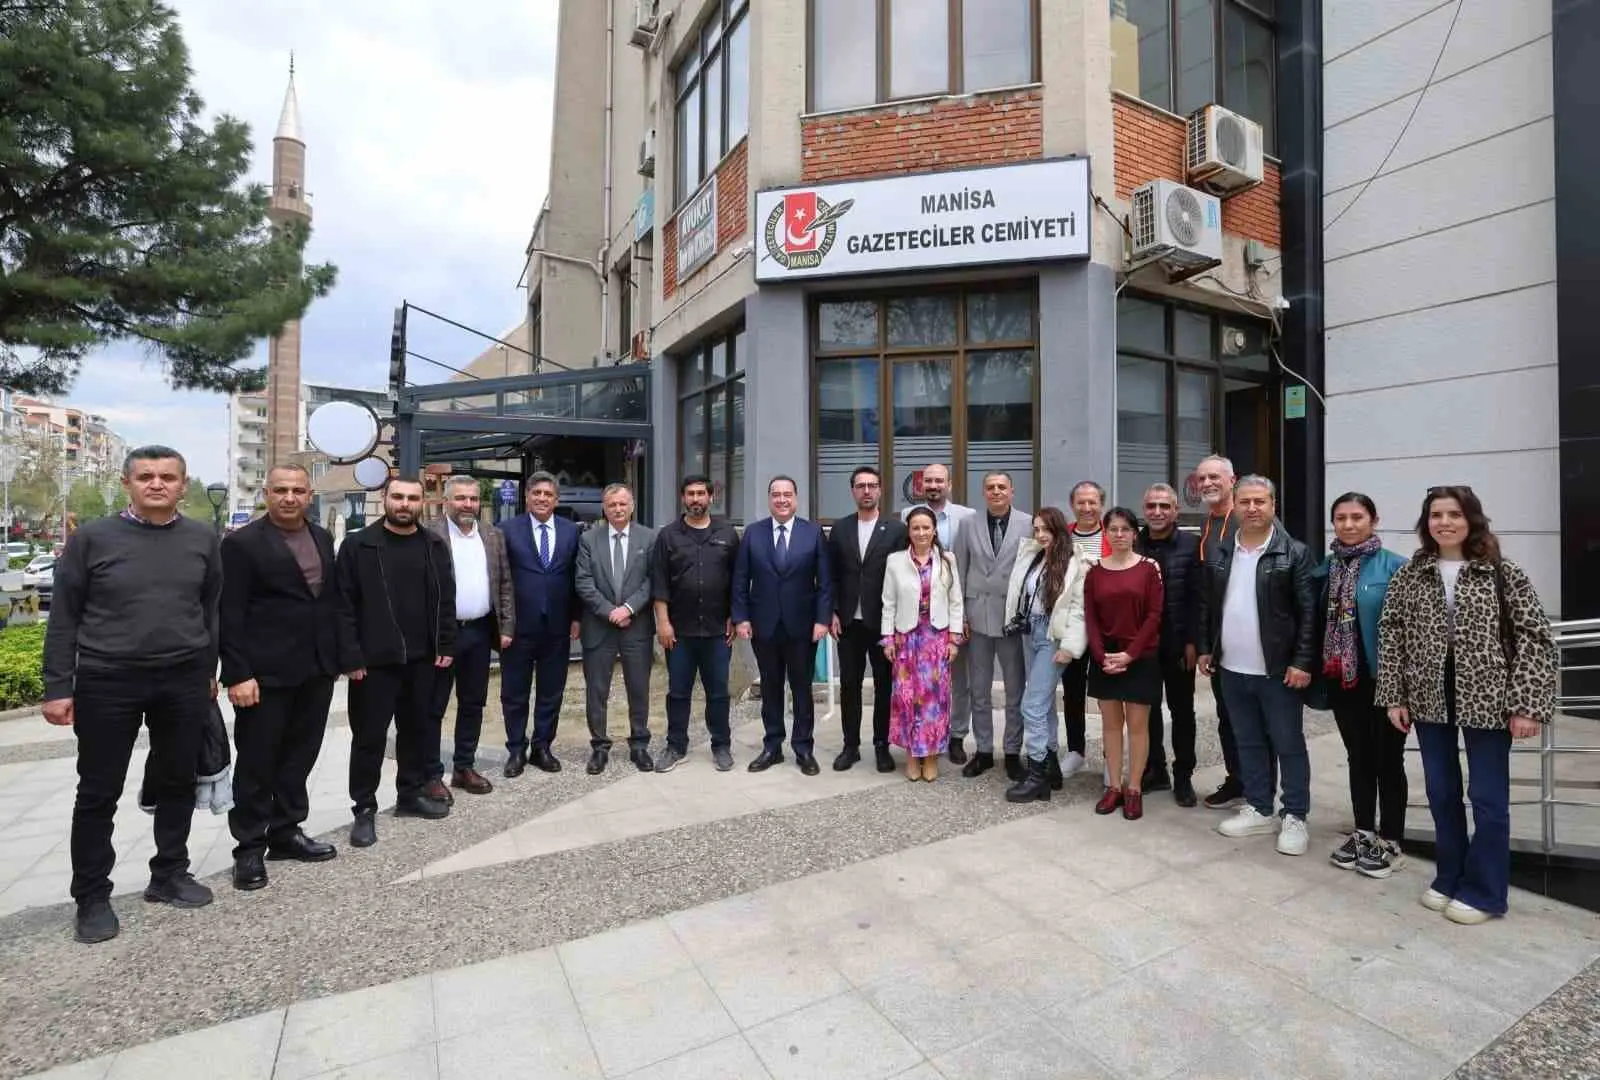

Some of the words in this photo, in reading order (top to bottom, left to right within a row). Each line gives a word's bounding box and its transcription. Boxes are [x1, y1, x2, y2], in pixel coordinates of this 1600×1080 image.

[921, 187, 995, 214] MANİSA
[847, 222, 975, 254] GAZETECİLER
[981, 211, 1076, 243] CEMİYETİ
[790, 252, 820, 265] MANİSA
